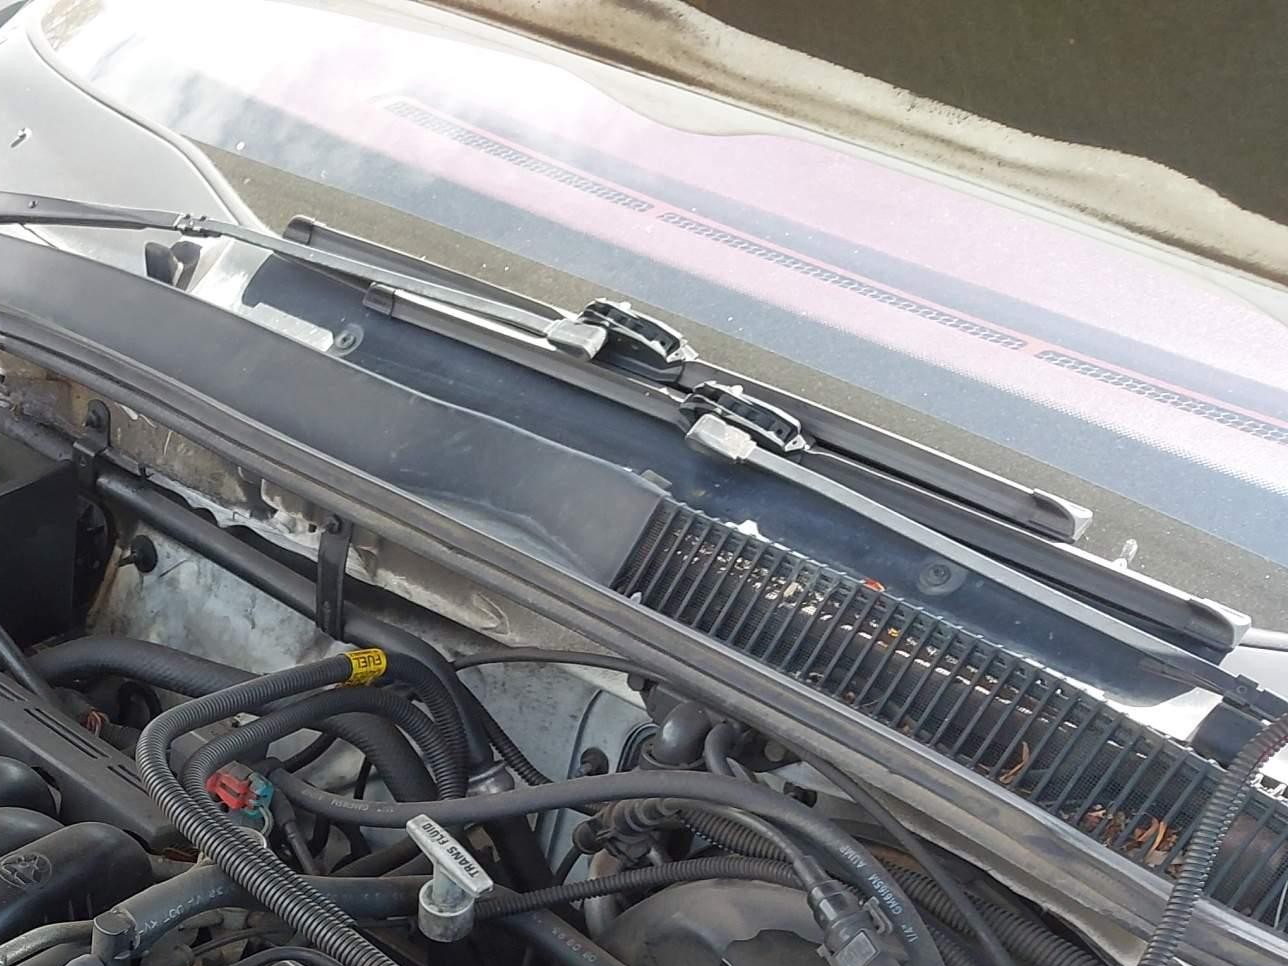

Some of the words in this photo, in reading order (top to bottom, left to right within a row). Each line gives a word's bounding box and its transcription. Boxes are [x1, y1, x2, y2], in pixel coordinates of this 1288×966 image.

[351, 654, 381, 668] FUEL
[421, 819, 449, 849] FLUID
[445, 842, 479, 880] TRANS
